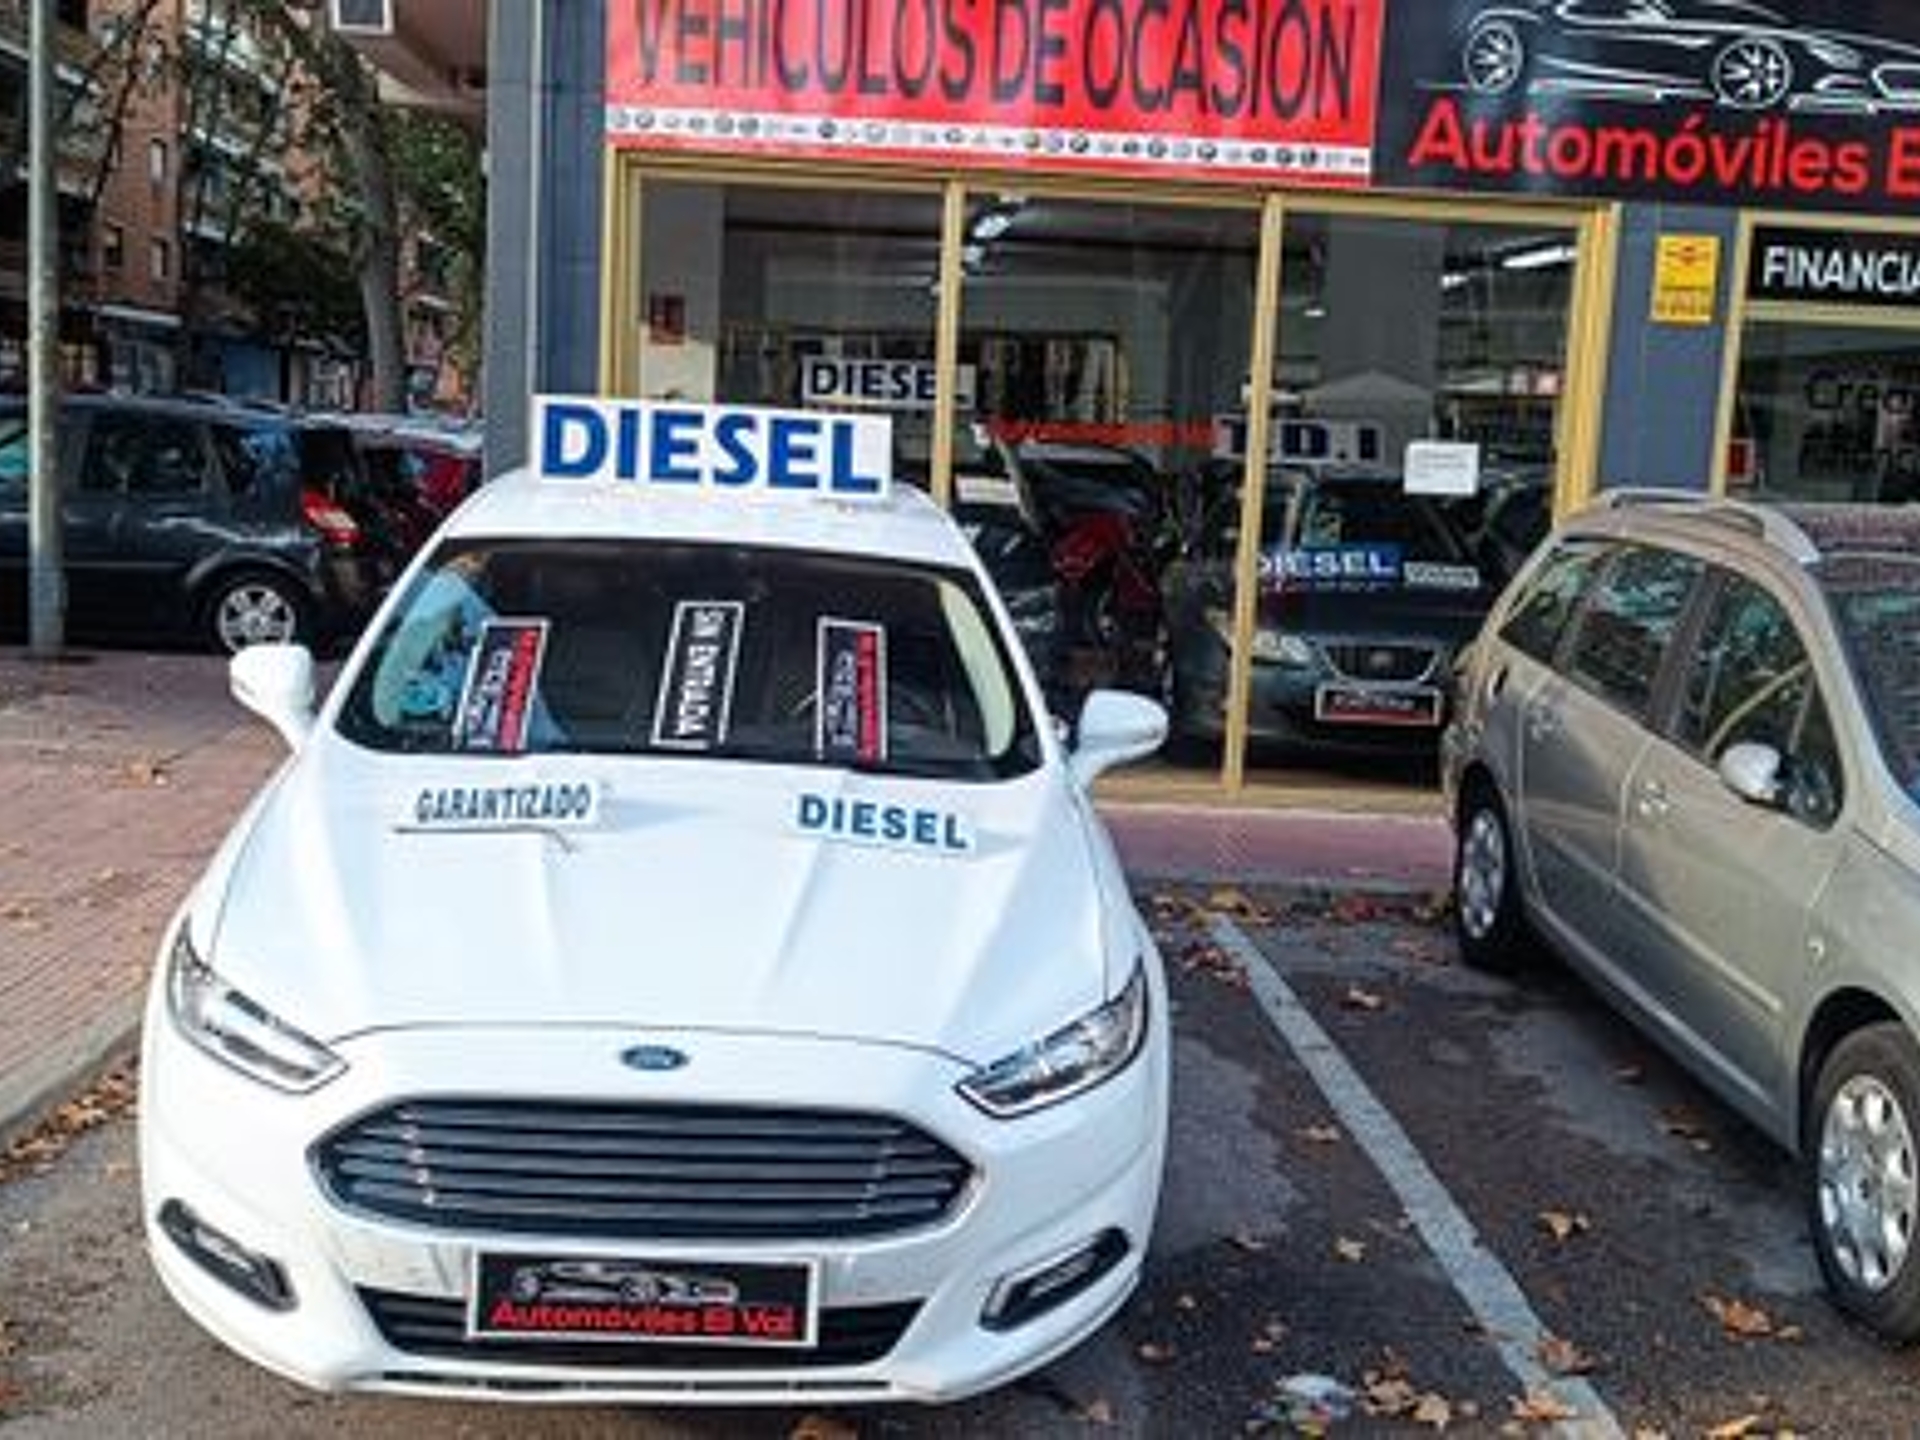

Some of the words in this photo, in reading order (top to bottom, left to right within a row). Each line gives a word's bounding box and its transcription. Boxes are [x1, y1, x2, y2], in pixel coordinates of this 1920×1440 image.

[991, 0, 1067, 107] DE
[1408, 97, 1868, 193] Automóviles
[541, 402, 881, 494] DIESEL
[416, 783, 592, 824] GARANTIZADO
[799, 794, 967, 850] DIESEL
